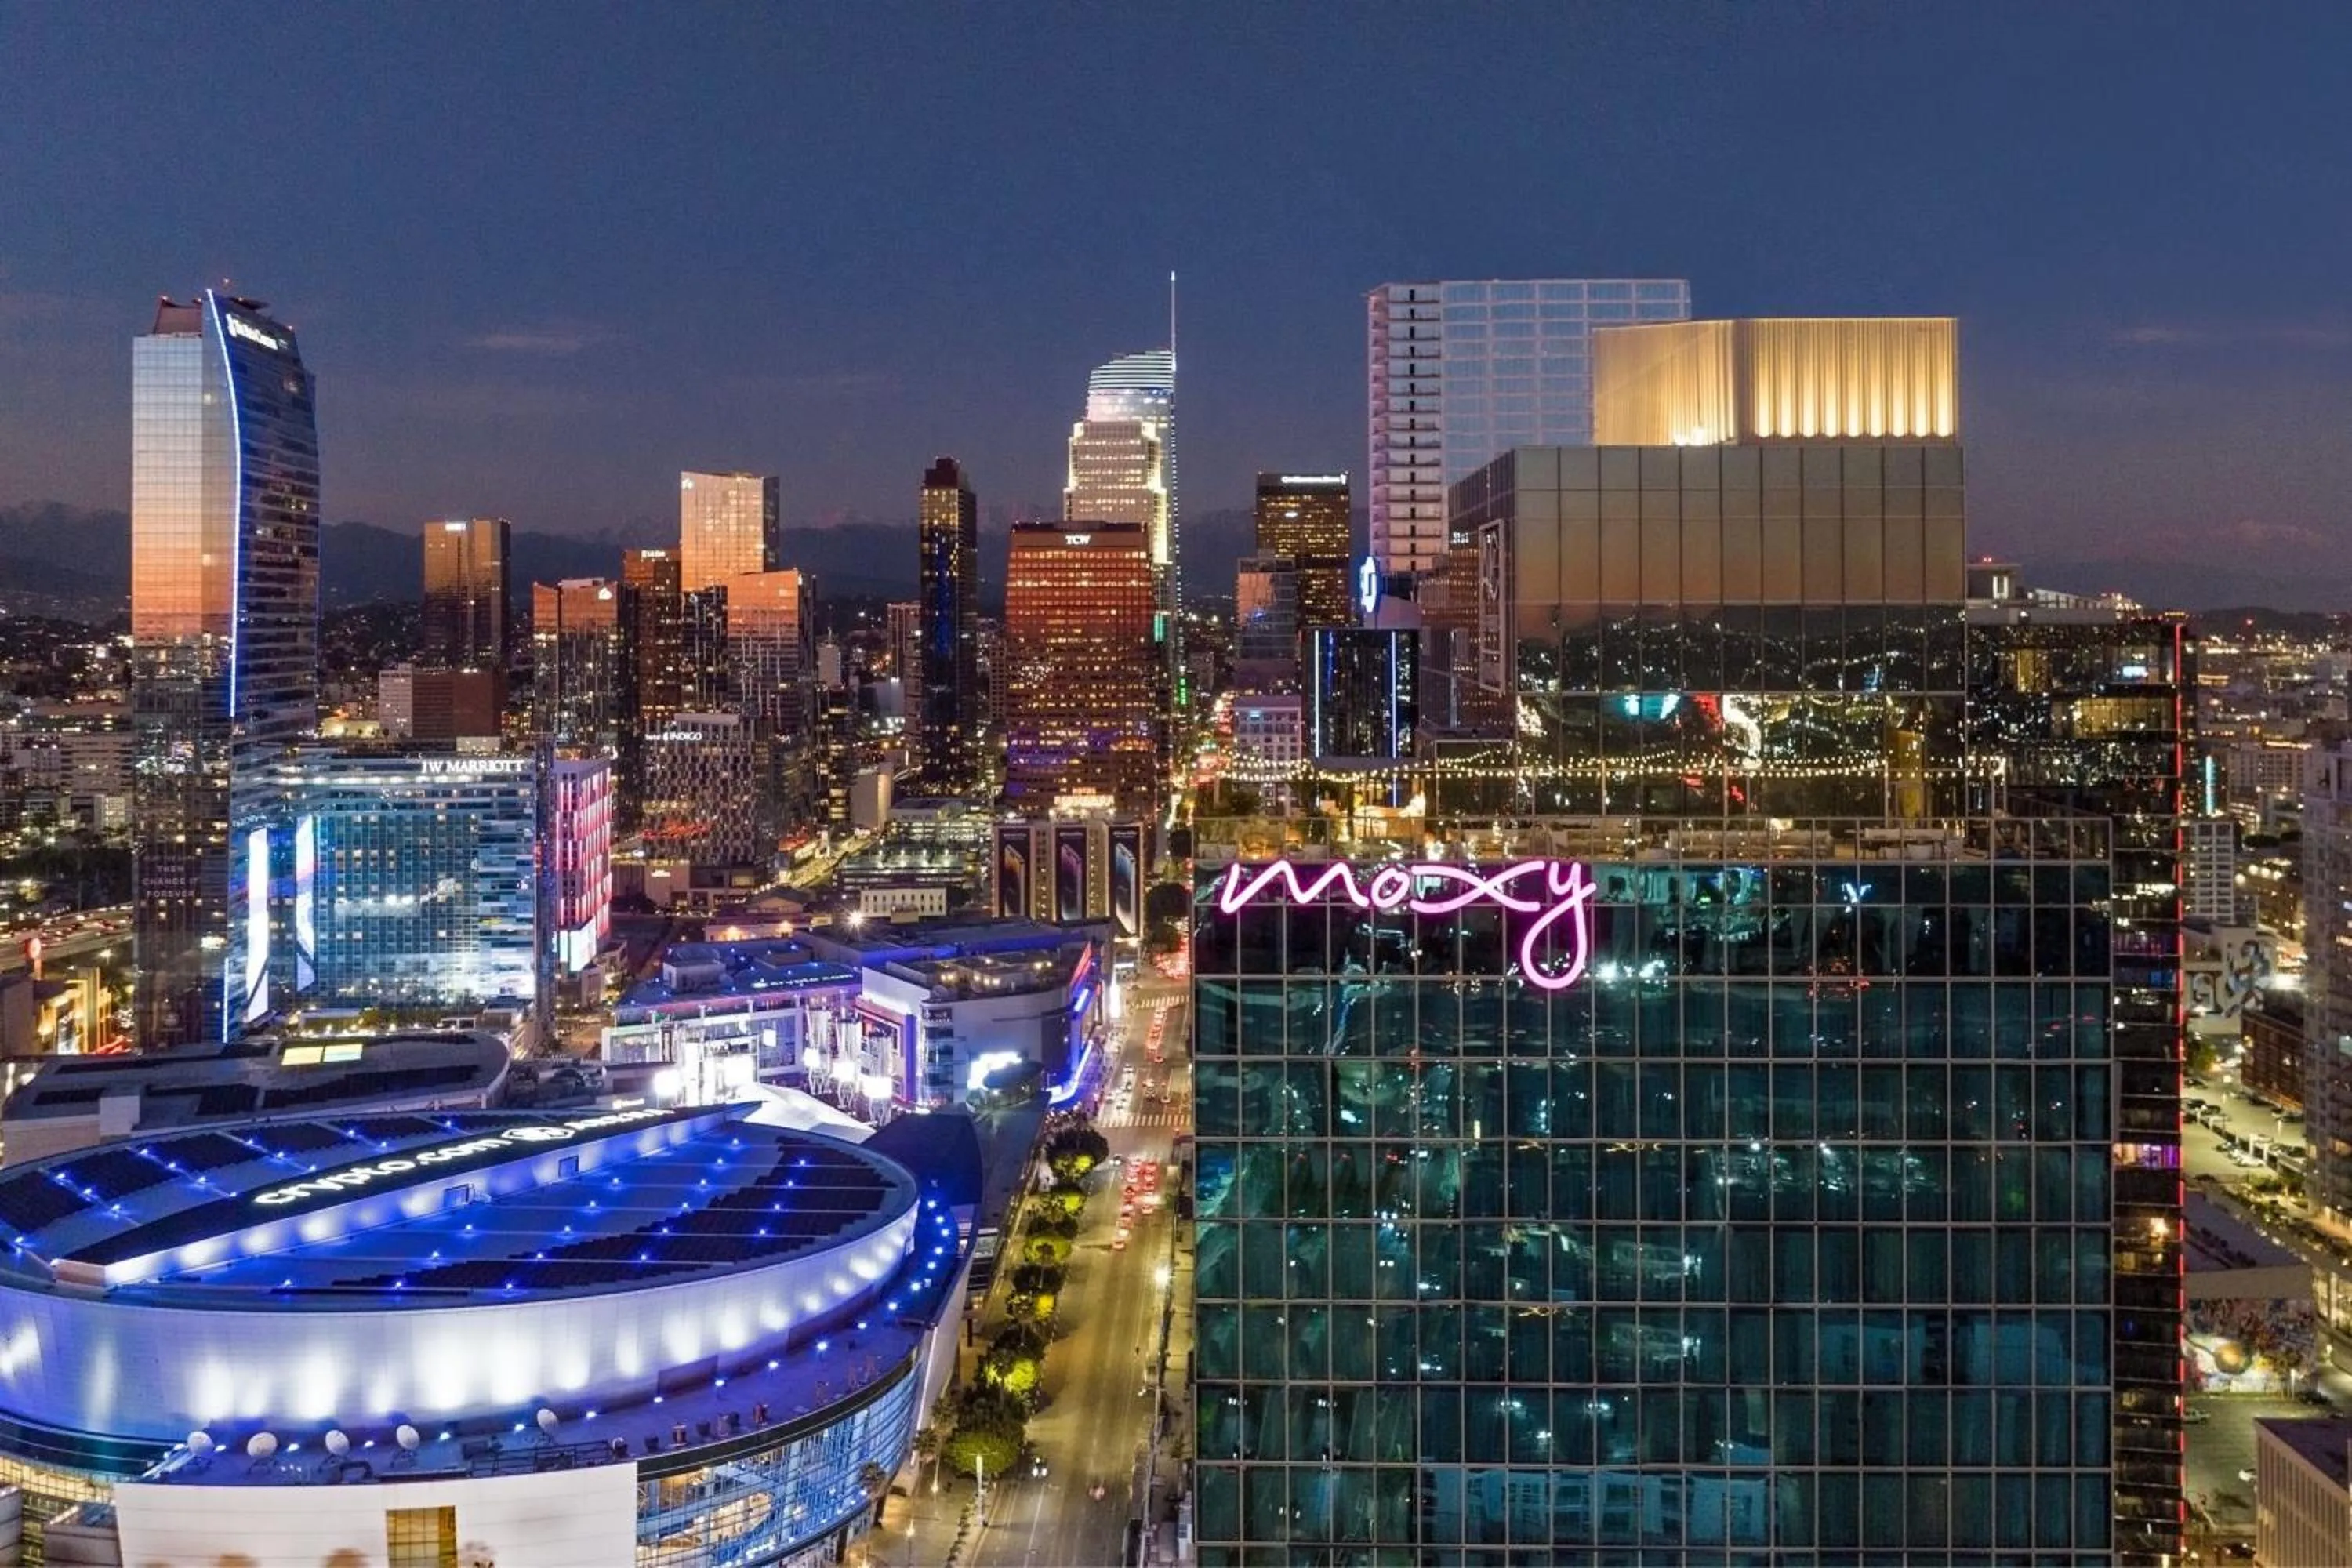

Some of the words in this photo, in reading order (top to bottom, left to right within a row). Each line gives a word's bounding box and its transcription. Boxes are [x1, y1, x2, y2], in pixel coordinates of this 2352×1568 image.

[1065, 534, 1091, 545] TCW
[670, 731, 702, 741] INDIGO
[421, 759, 444, 774] JW
[445, 759, 524, 772] MARRIOTT
[254, 1138, 514, 1205] crypto.com
